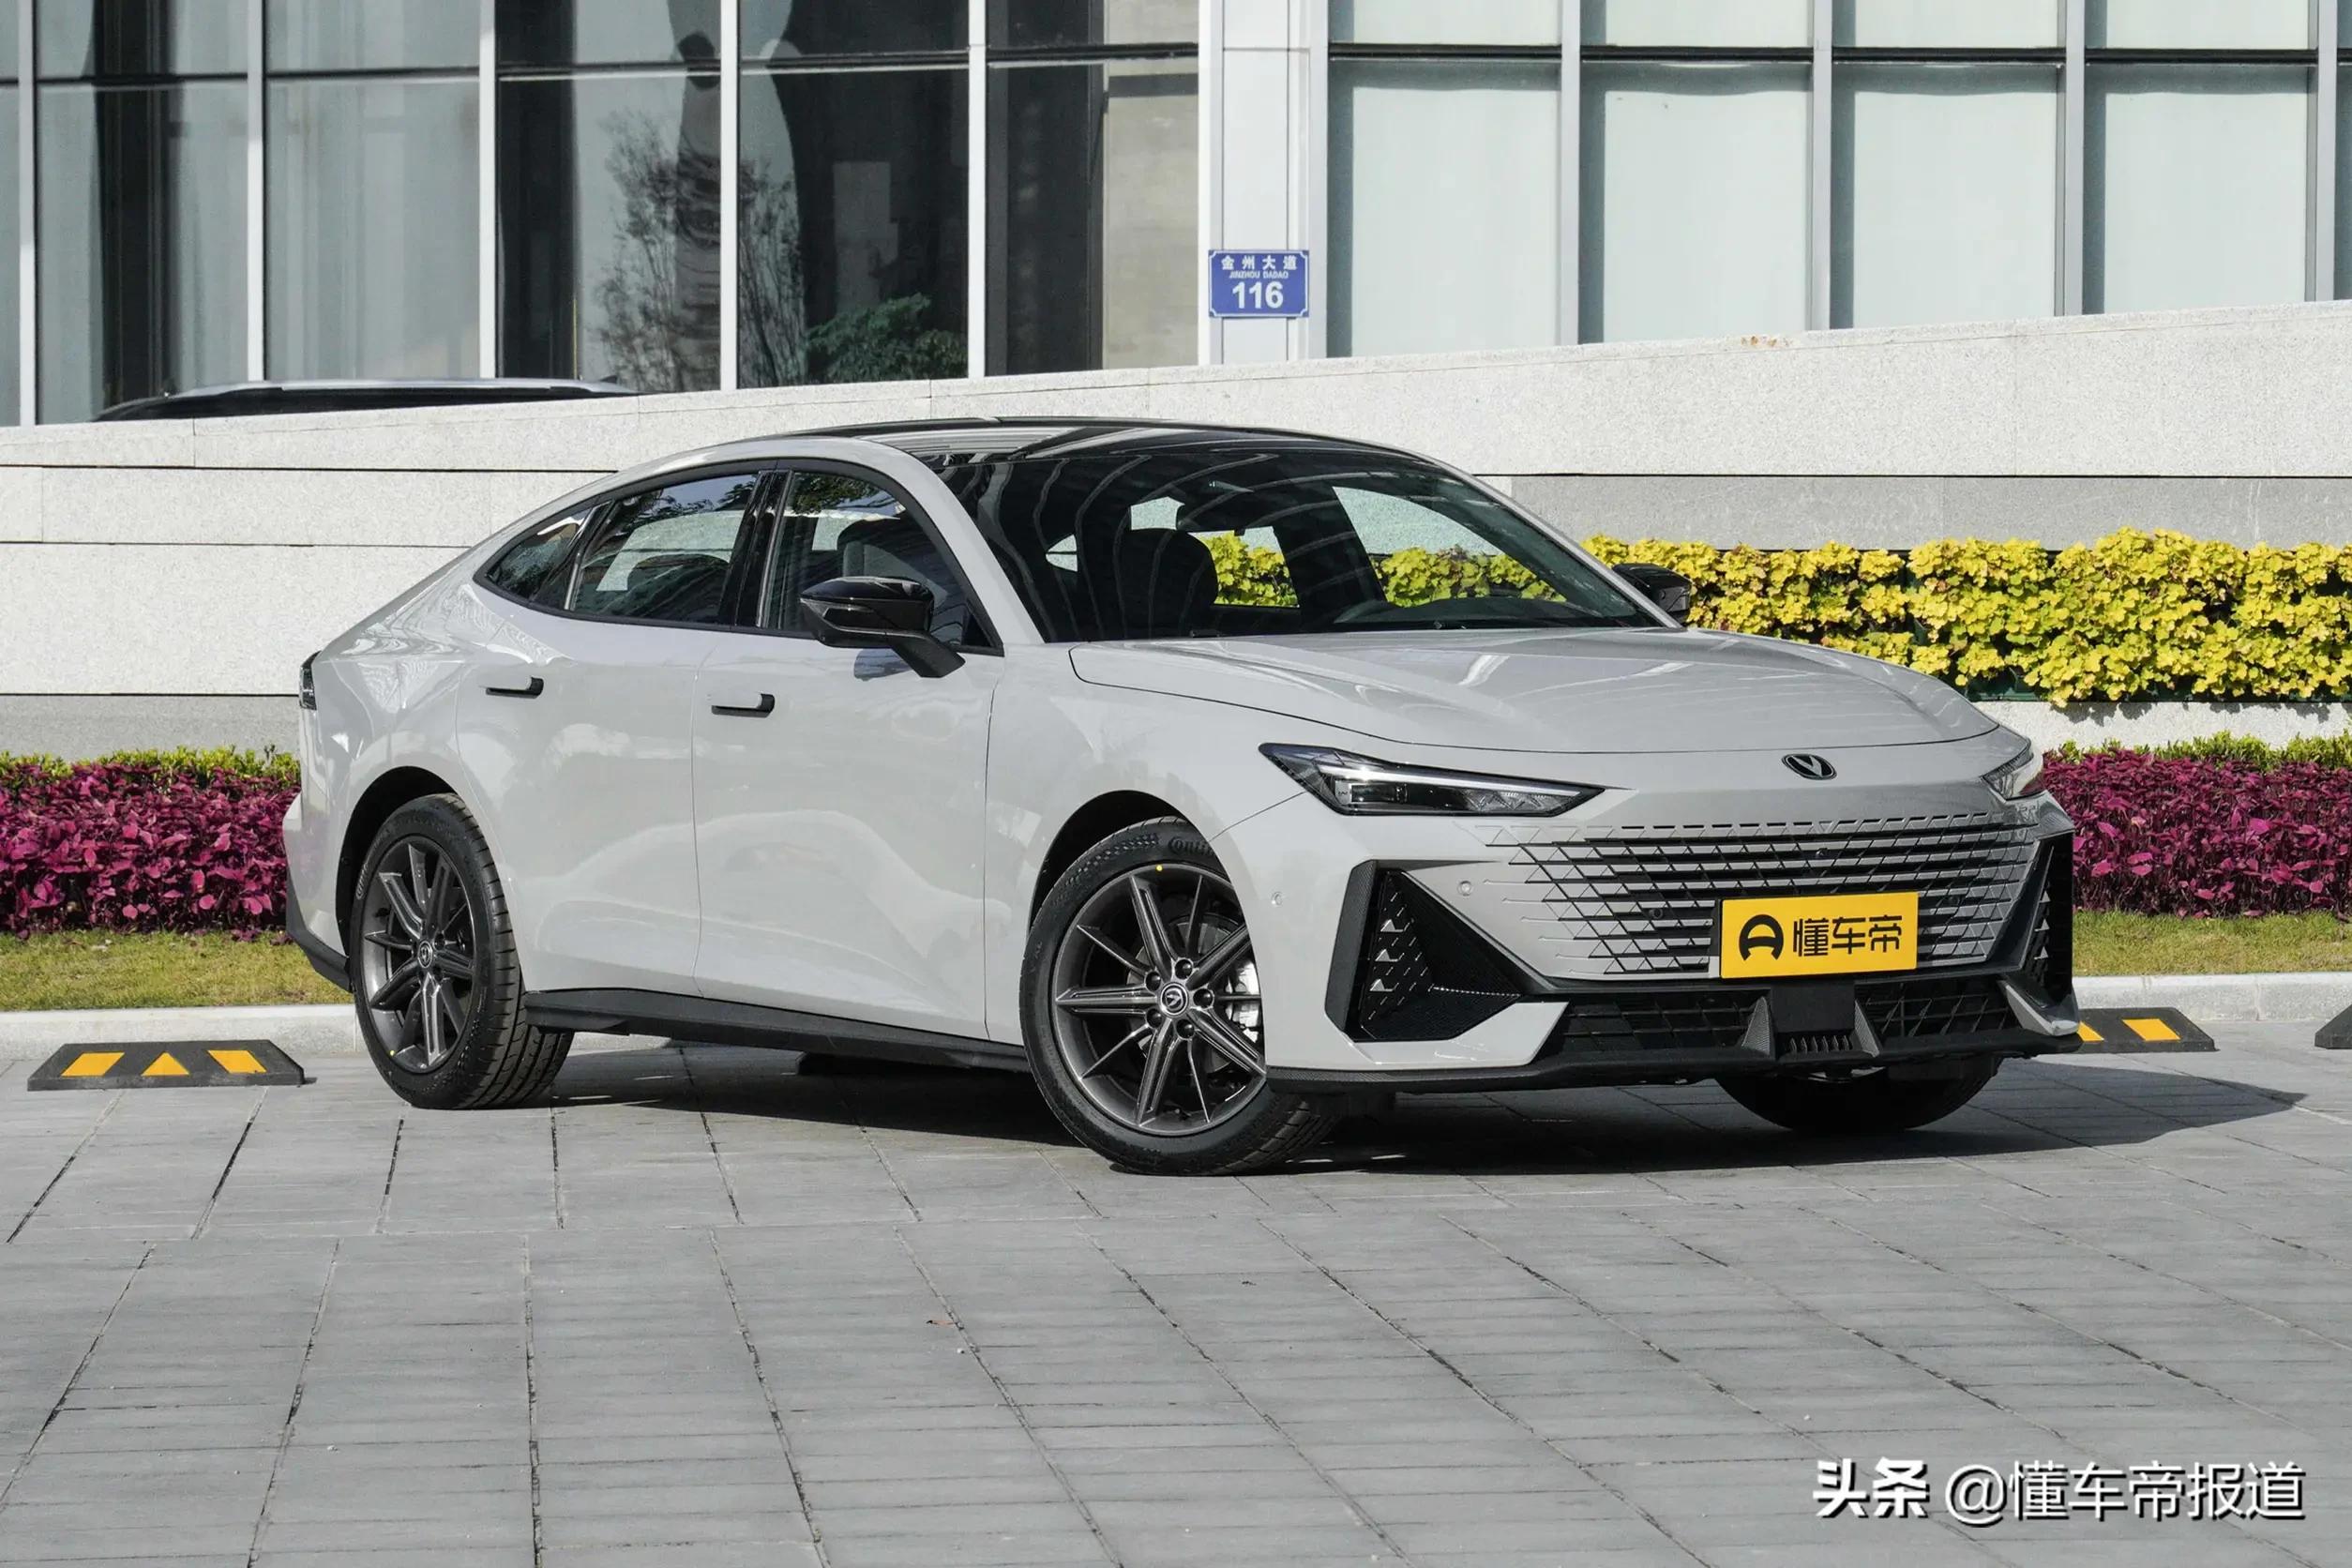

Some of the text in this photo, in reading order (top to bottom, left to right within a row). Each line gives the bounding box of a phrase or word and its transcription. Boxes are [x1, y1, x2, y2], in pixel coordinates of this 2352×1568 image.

[1221, 255, 1297, 270] 金州大道
[1229, 270, 1289, 279] JINZHOU DADAO
[1232, 281, 1283, 309] 116
[1792, 914, 1903, 957] 懂车帝
